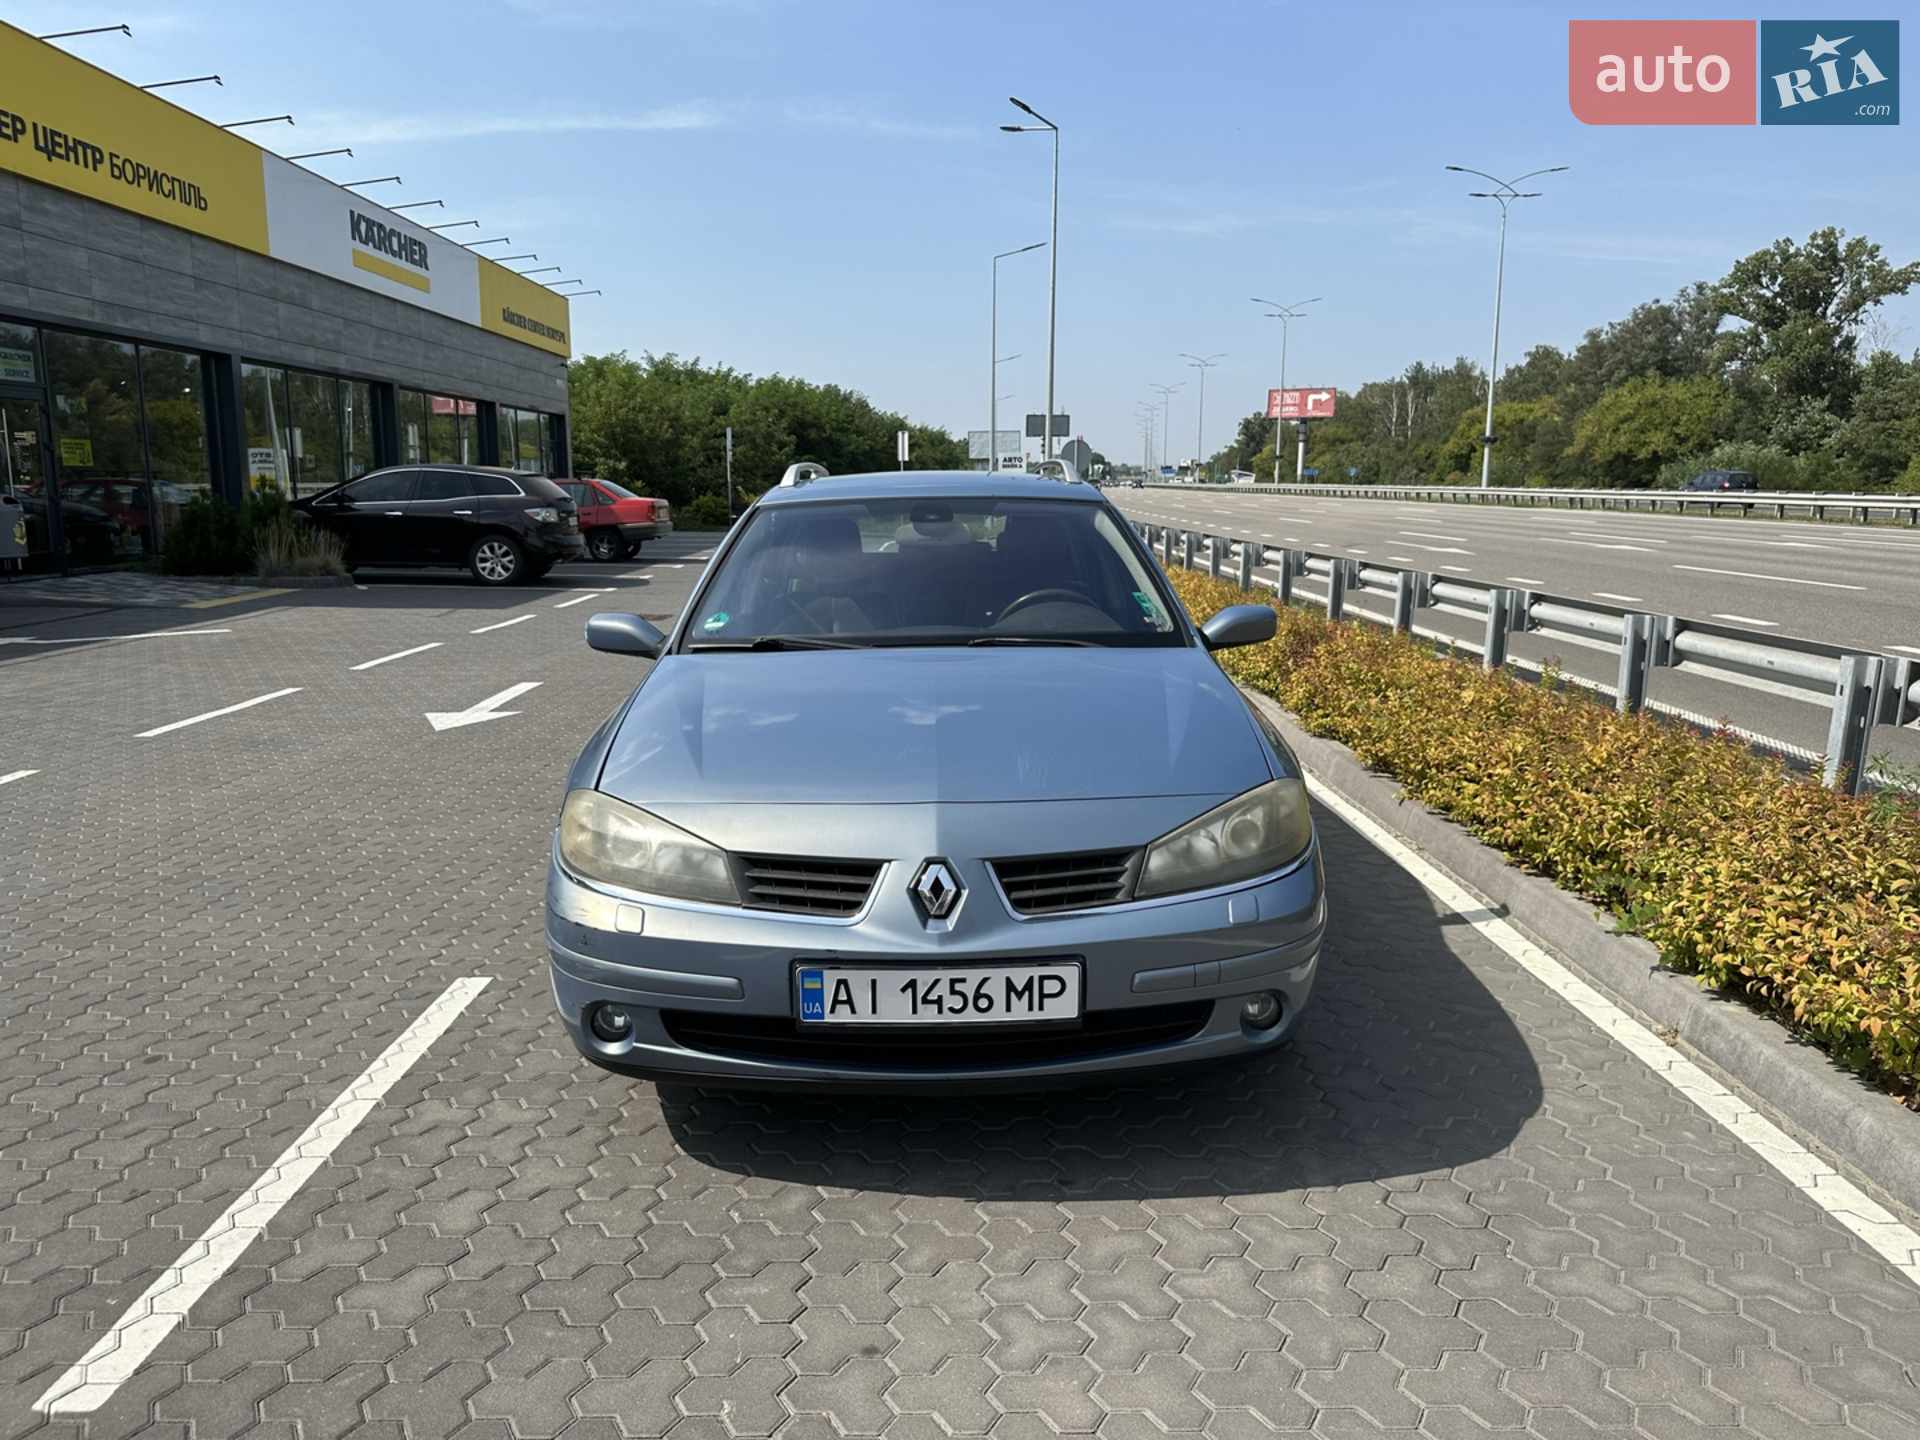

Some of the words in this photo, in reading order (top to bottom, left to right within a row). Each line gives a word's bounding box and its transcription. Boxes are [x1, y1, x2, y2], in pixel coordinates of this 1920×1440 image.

[32, 121, 104, 172] ЦЕНТР
[109, 152, 208, 211] БОРИСПІЛЬ
[349, 209, 430, 271] KÄRCHER
[804, 1002, 822, 1014] UA
[900, 977, 994, 1015] 1456
[1005, 974, 1067, 1013] MP
